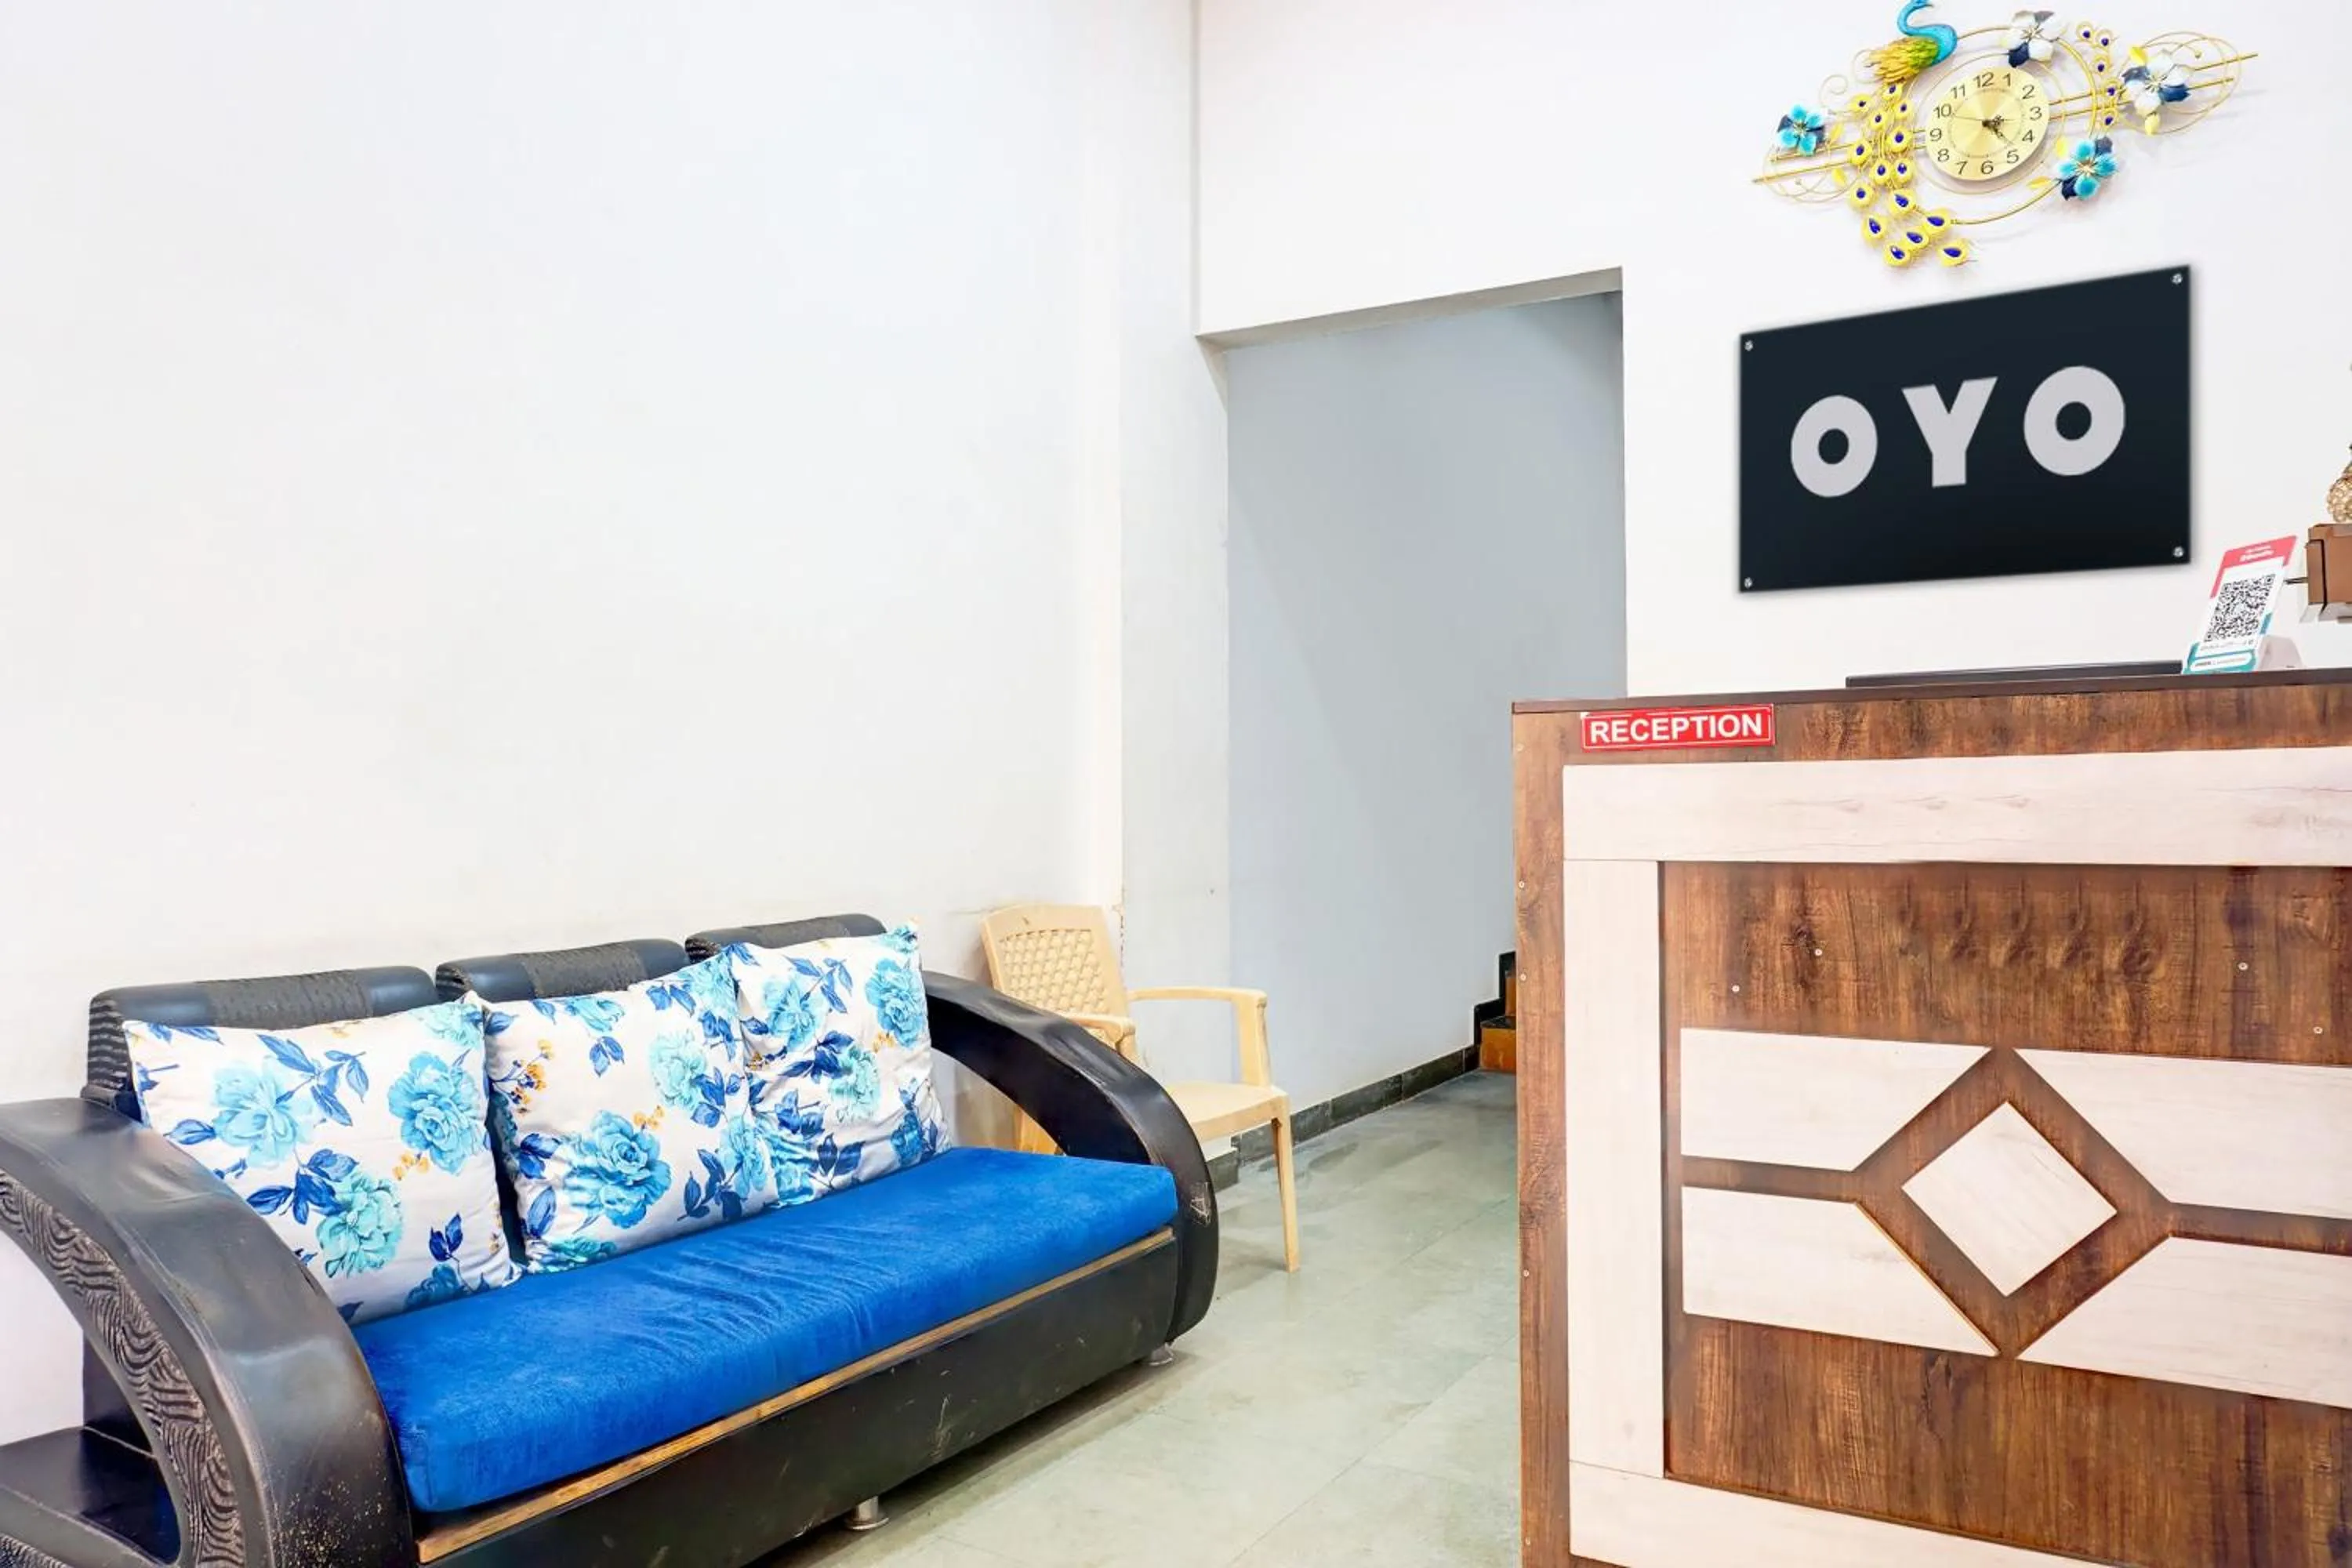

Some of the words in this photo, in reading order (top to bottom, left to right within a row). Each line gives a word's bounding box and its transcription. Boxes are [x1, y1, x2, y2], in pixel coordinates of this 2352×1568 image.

[1973, 71, 1994, 88] 12
[2002, 73, 2012, 86] 1
[1950, 84, 1966, 99] 11
[2022, 85, 2035, 100] 2
[1933, 103, 1952, 118] 10
[2030, 107, 2042, 121] 3
[1929, 128, 1942, 142] 9
[2021, 129, 2035, 143] 4
[1937, 149, 1950, 162] 8
[2006, 149, 2020, 164] 5
[1956, 162, 1968, 175] 7
[1980, 161, 1994, 175] 6
[1791, 365, 2126, 498] OYO
[1590, 713, 1762, 744] RECEPTION
